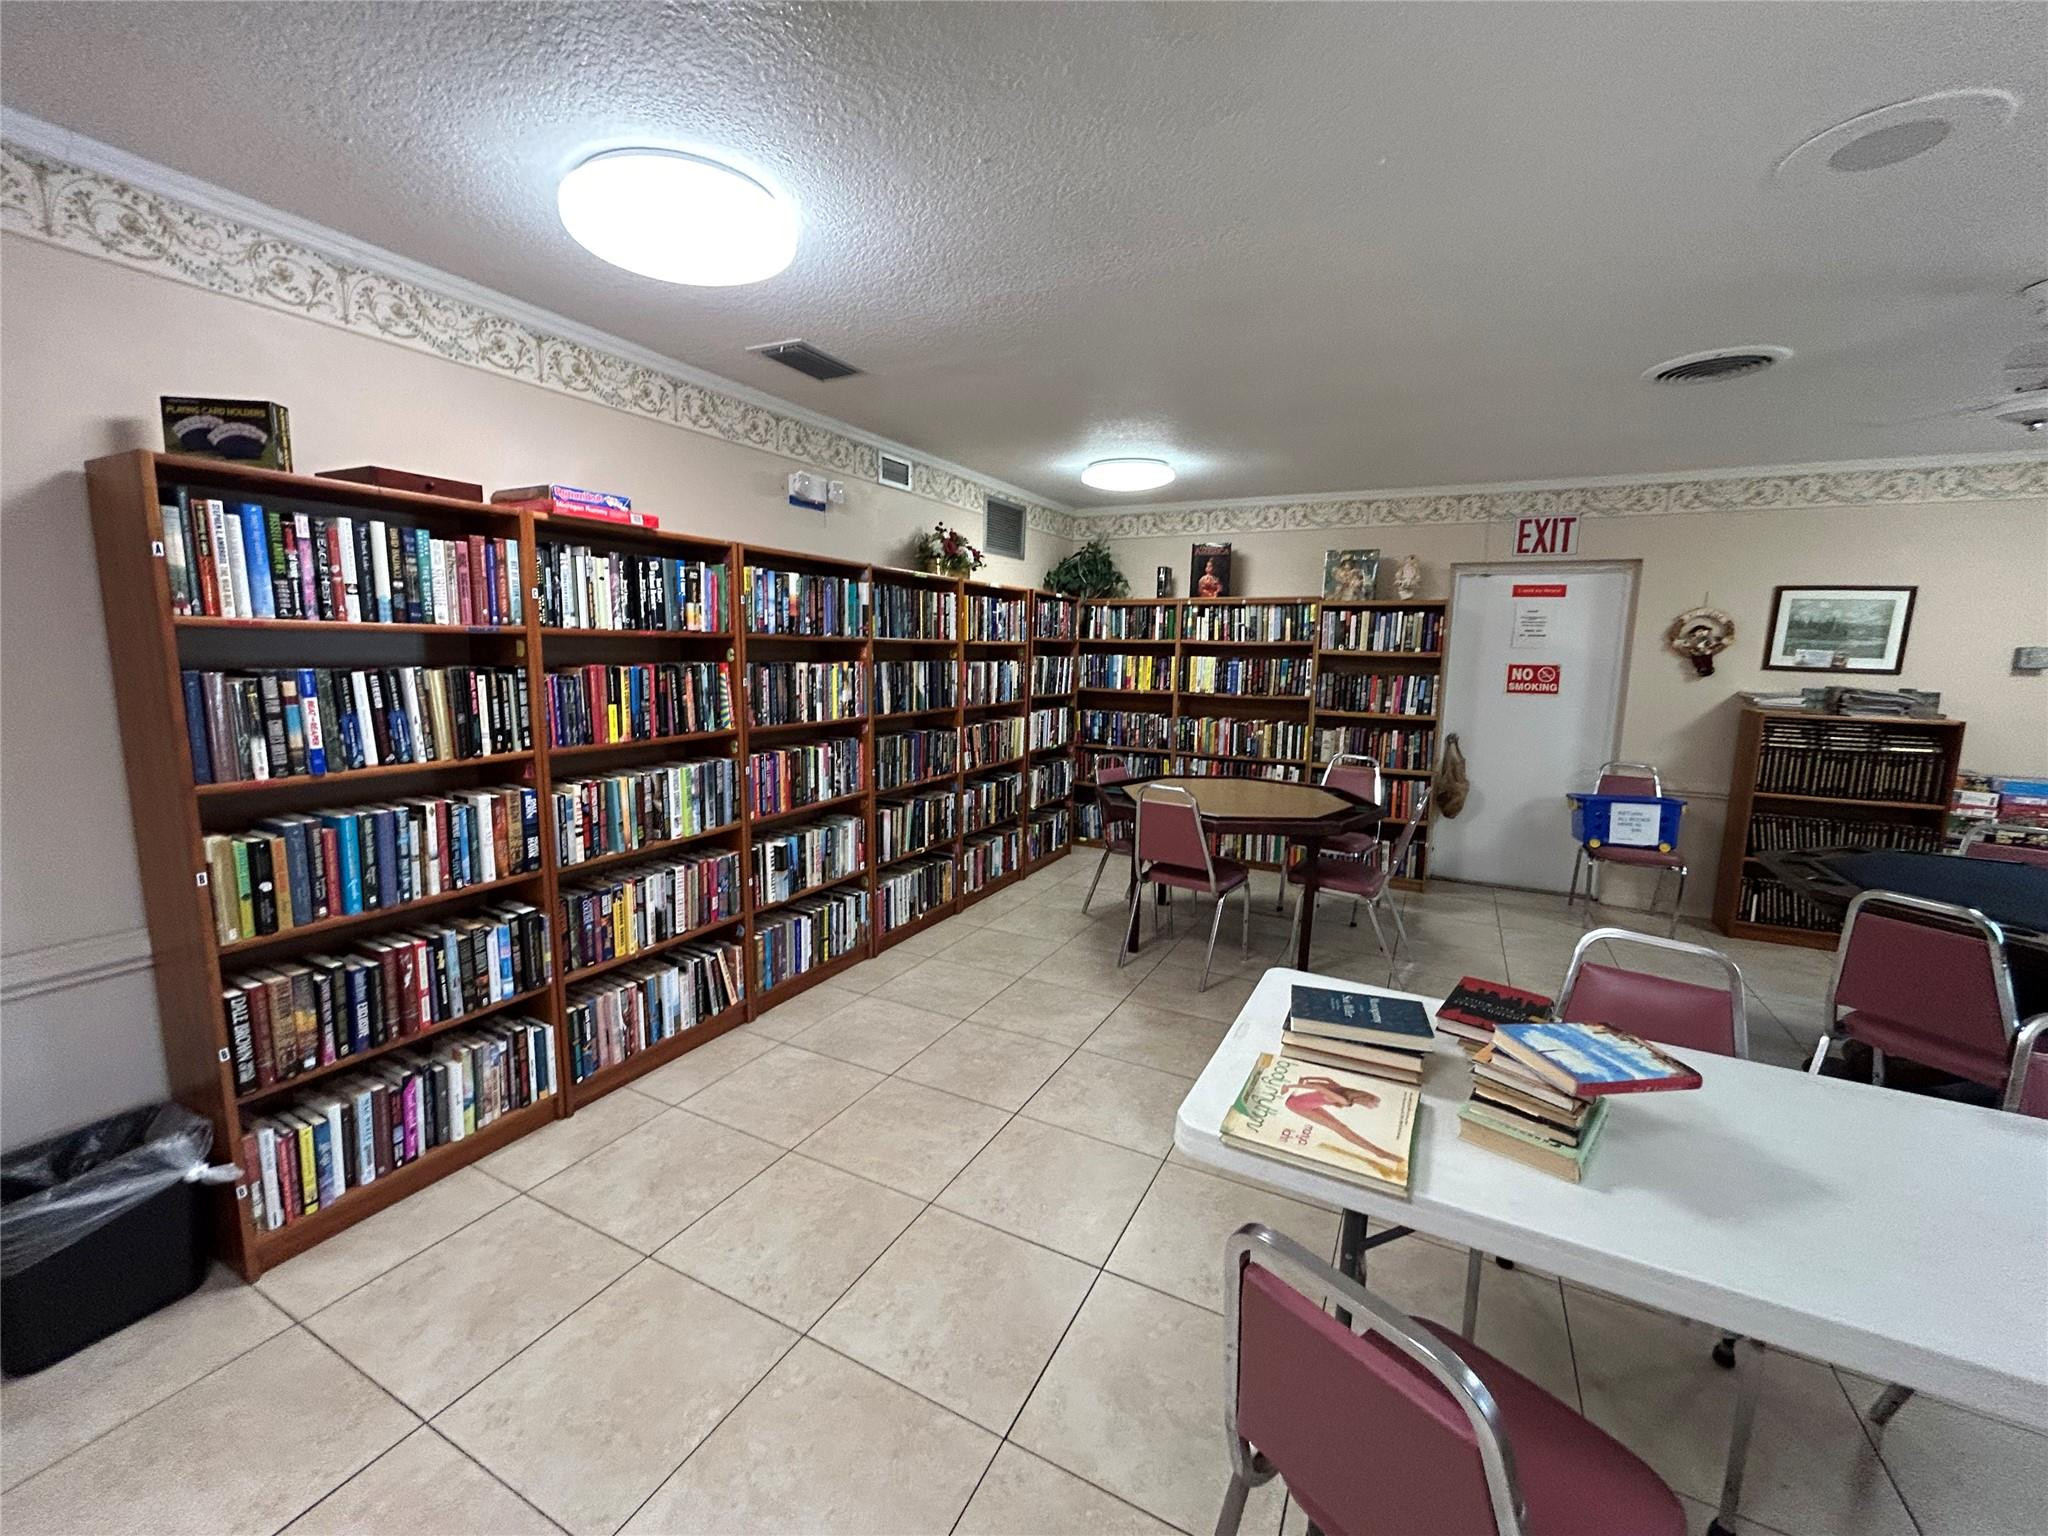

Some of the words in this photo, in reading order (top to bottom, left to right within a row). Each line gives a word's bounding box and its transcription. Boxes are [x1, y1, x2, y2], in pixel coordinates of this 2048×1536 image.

[166, 404, 199, 415] PLAYING
[201, 406, 225, 416] CARD
[227, 406, 265, 418] HOLDERS
[1516, 517, 1577, 553] EXIT
[316, 538, 329, 574] EAGLE
[422, 566, 430, 579] THE
[320, 574, 332, 607] HEIST
[423, 582, 433, 616] SUSPECT
[1507, 682, 1558, 692] SMOKING
[1511, 668, 1534, 680] NO
[307, 700, 316, 717] BEAT
[310, 722, 320, 746] REAPER
[230, 996, 249, 1024] DALE
[233, 1022, 253, 1063] BROWN
[1269, 1060, 1299, 1088] body
